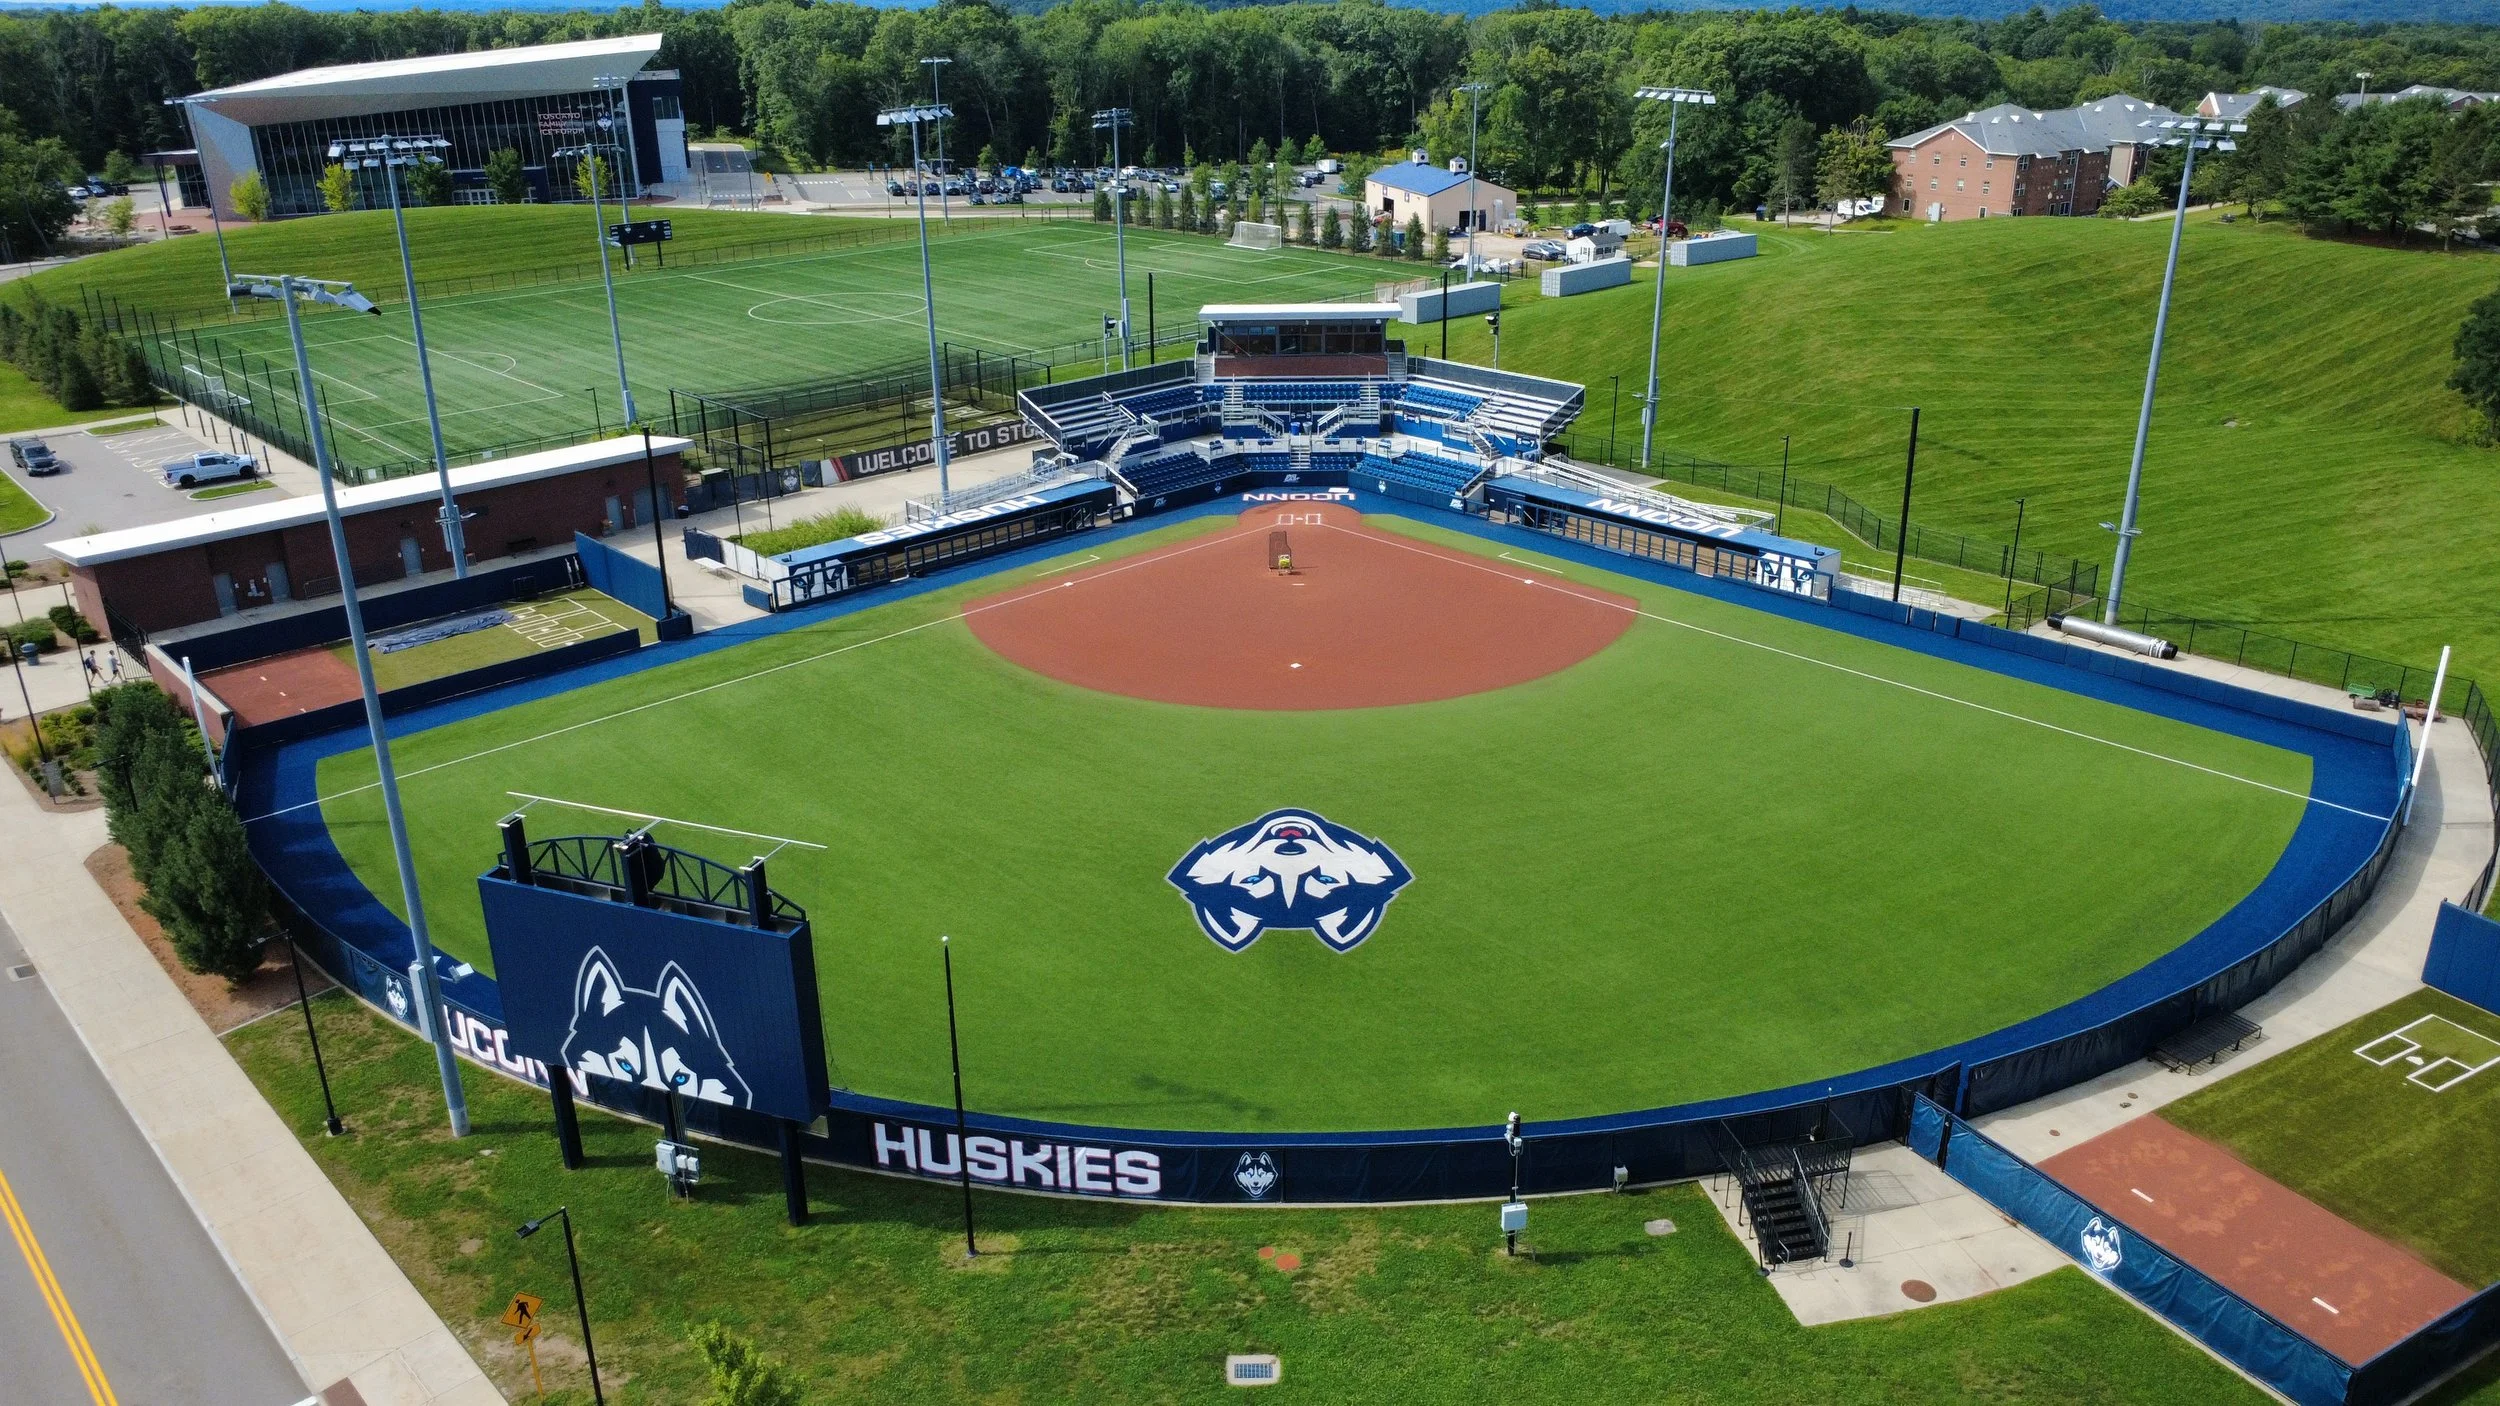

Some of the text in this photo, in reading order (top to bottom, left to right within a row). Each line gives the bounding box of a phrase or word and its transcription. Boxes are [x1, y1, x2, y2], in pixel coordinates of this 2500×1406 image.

[964, 430, 991, 451] TO
[1242, 492, 1356, 501] UCONN
[853, 494, 1050, 546] HUSKIES
[1586, 498, 1744, 538] UCONN
[873, 1122, 1162, 1194] HUSKIES
